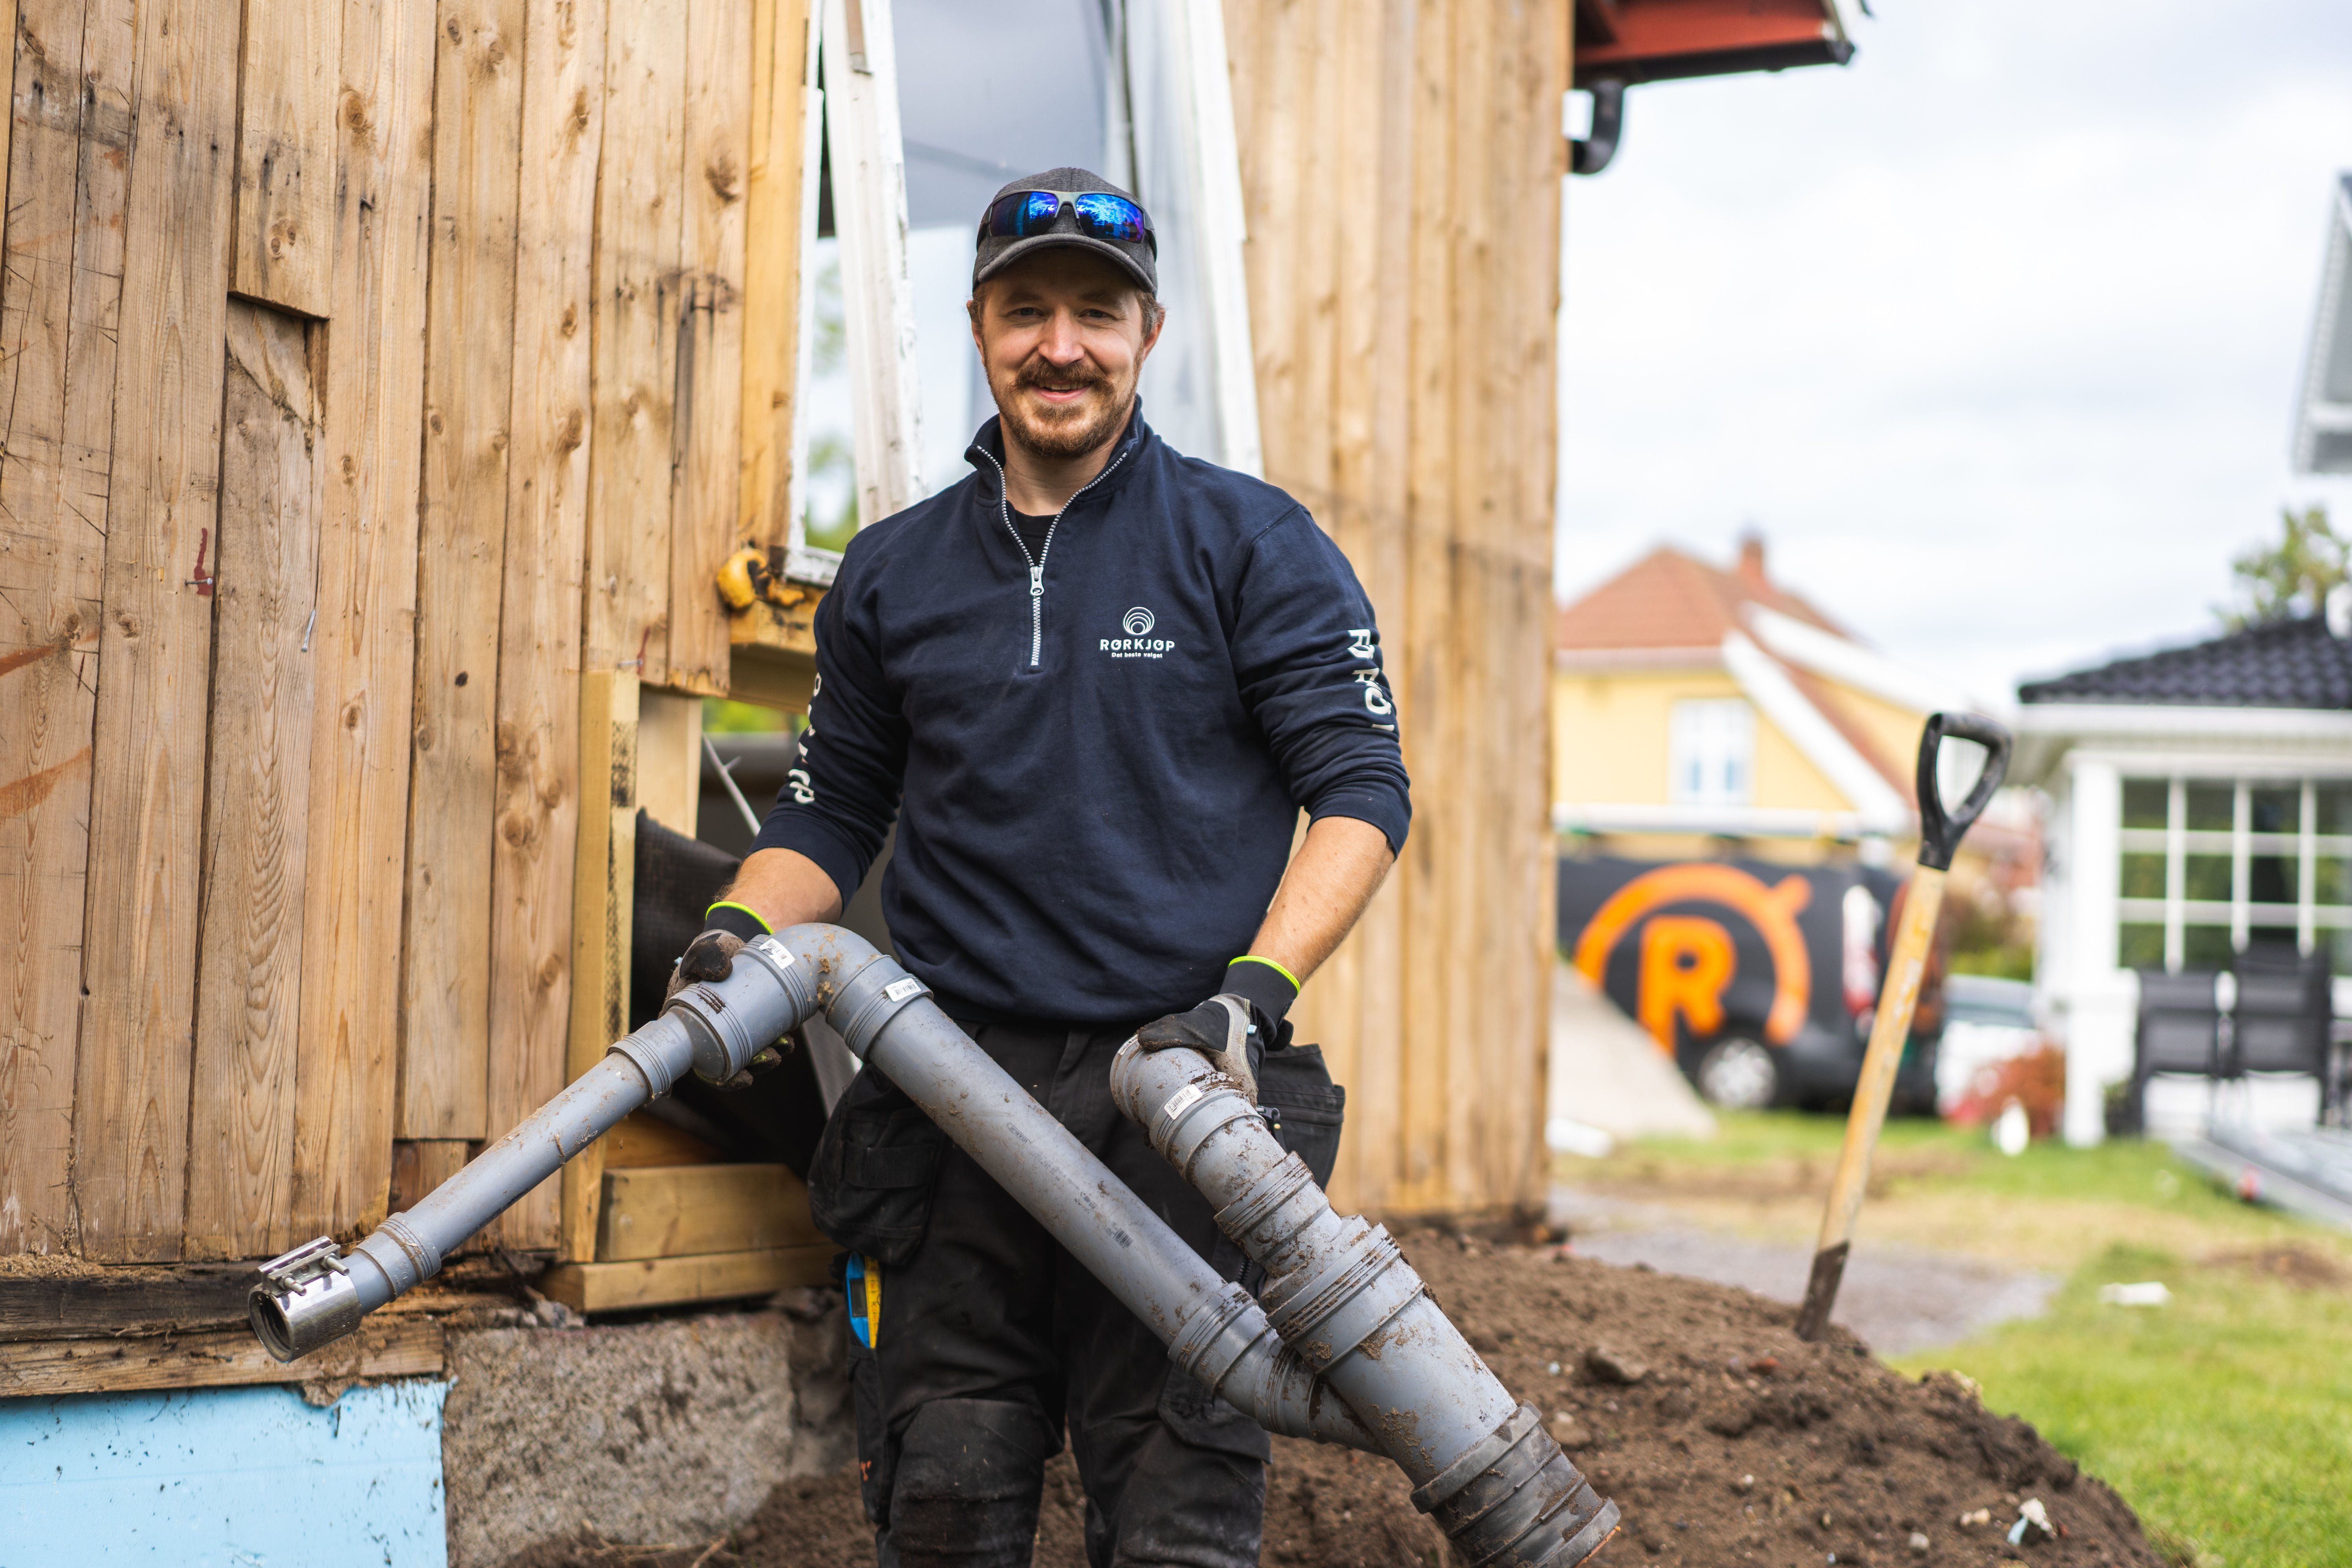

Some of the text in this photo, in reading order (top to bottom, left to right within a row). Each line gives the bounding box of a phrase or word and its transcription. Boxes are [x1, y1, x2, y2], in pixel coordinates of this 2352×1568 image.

[1100, 639, 1175, 651] RØRKJØP
[1638, 915, 1737, 1060] R
[1010, 1125, 1028, 1143] wavin
